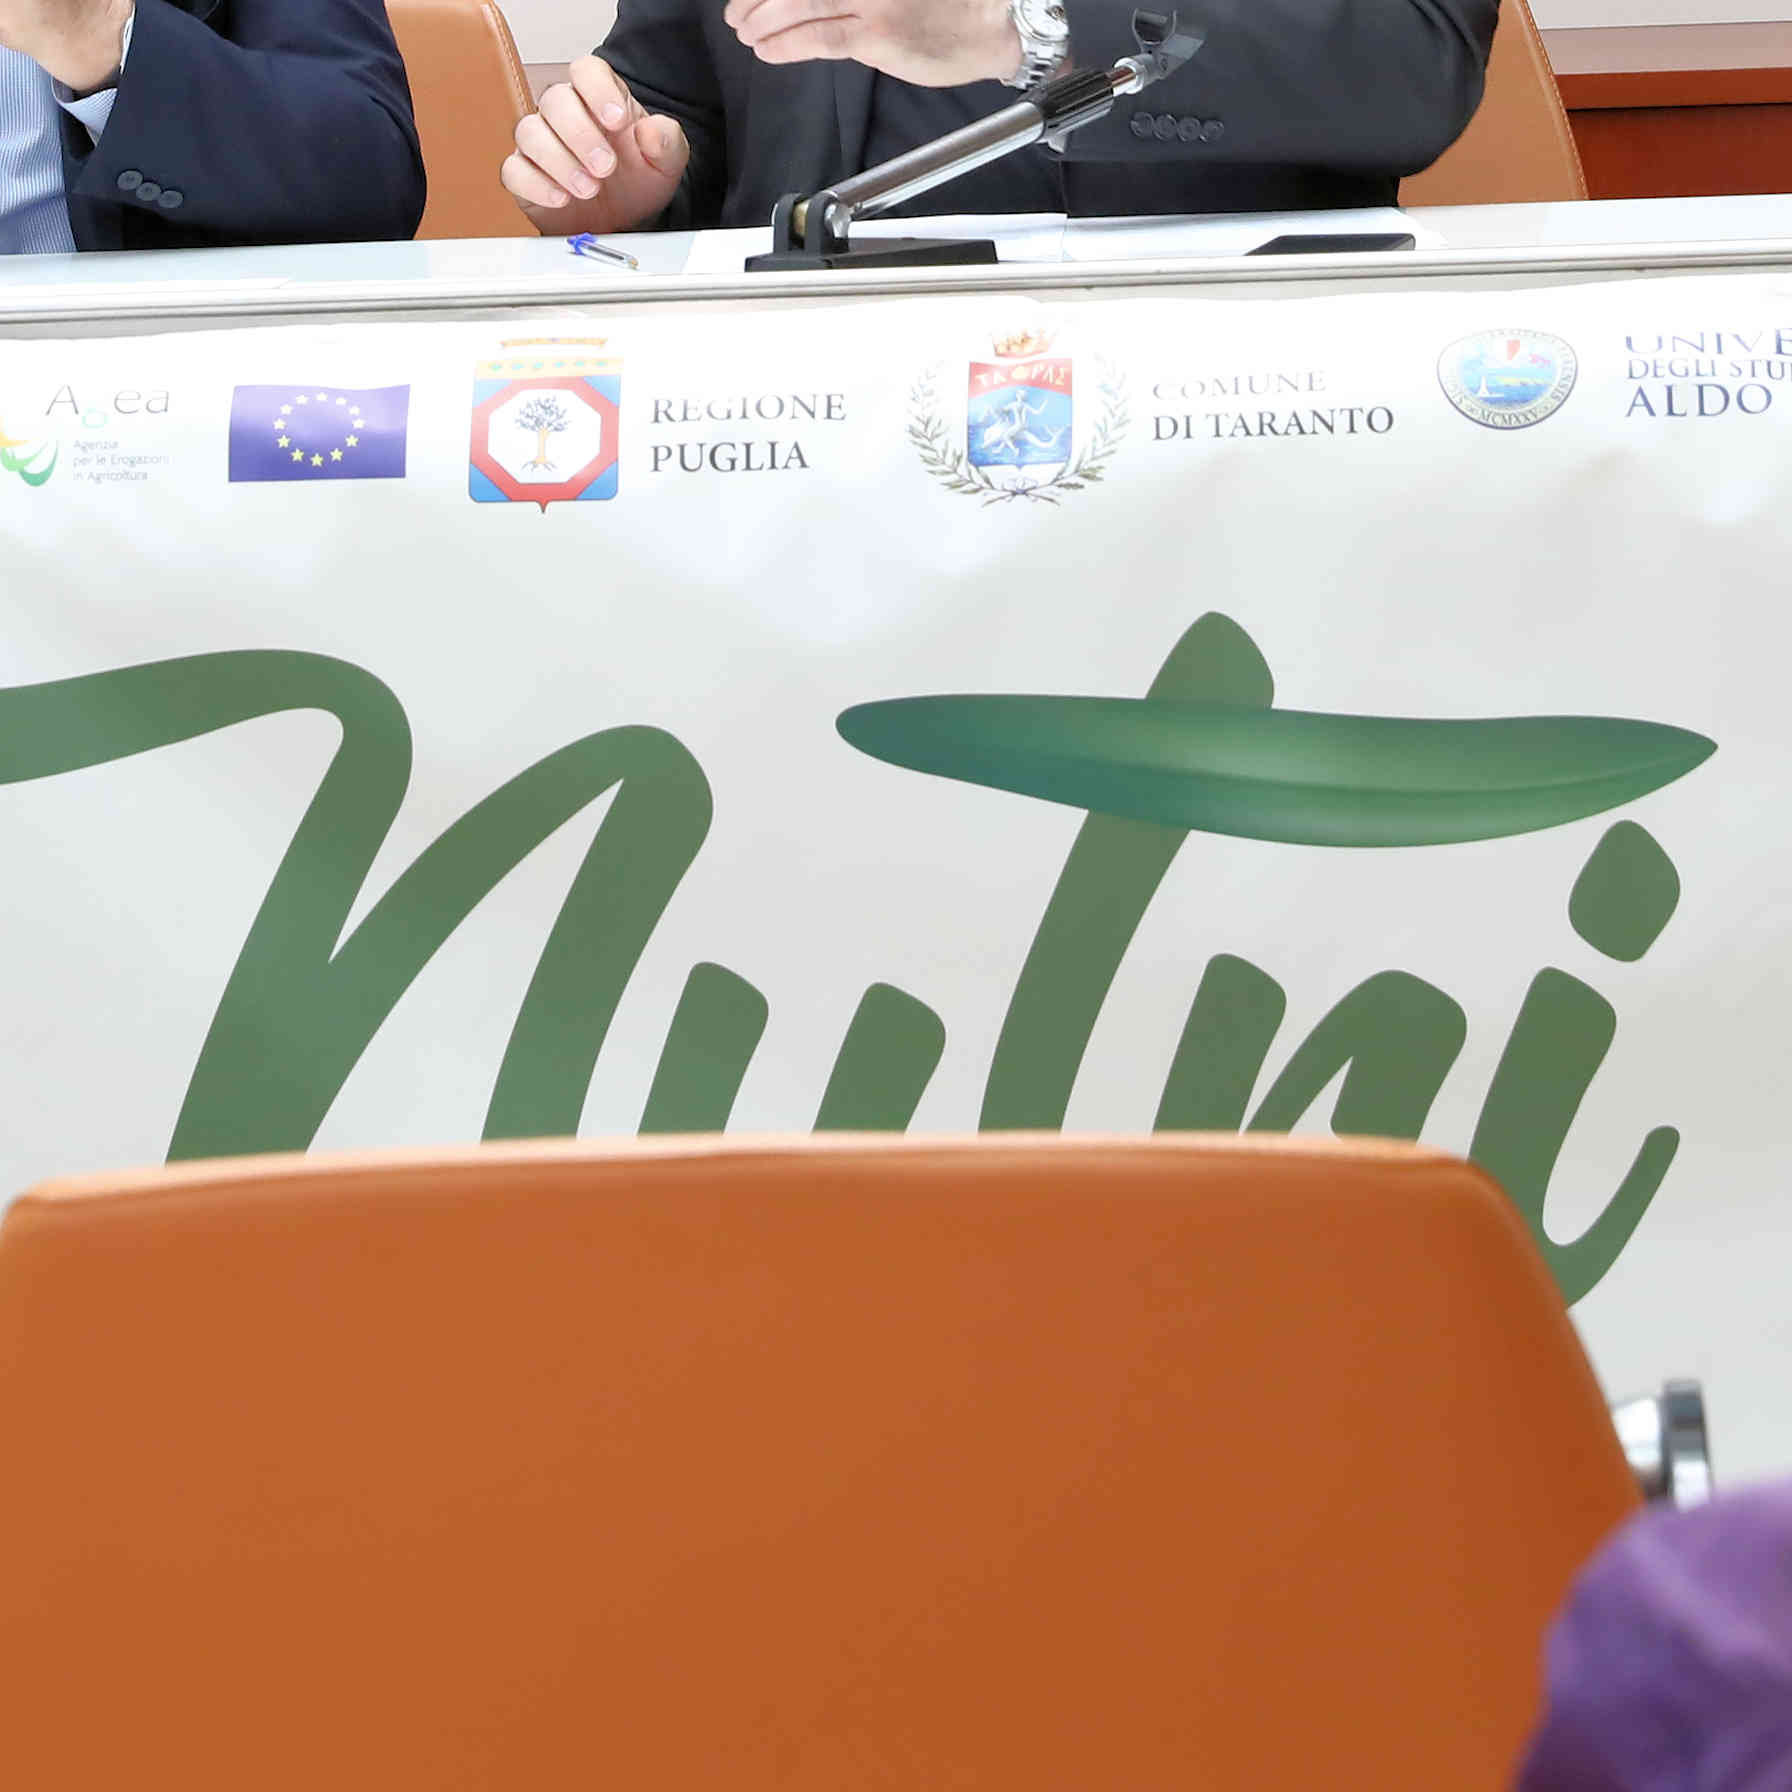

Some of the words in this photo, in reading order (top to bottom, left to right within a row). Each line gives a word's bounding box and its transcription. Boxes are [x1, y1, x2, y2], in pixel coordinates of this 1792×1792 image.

[1153, 370, 1327, 401] COMUNE
[1627, 358, 1716, 380] DEGLI
[652, 391, 847, 425] REGIONE
[1625, 382, 1773, 418] ALDO
[1153, 414, 1193, 441] DI
[1205, 406, 1395, 440] TARANTO
[650, 440, 809, 473] PUGLIA
